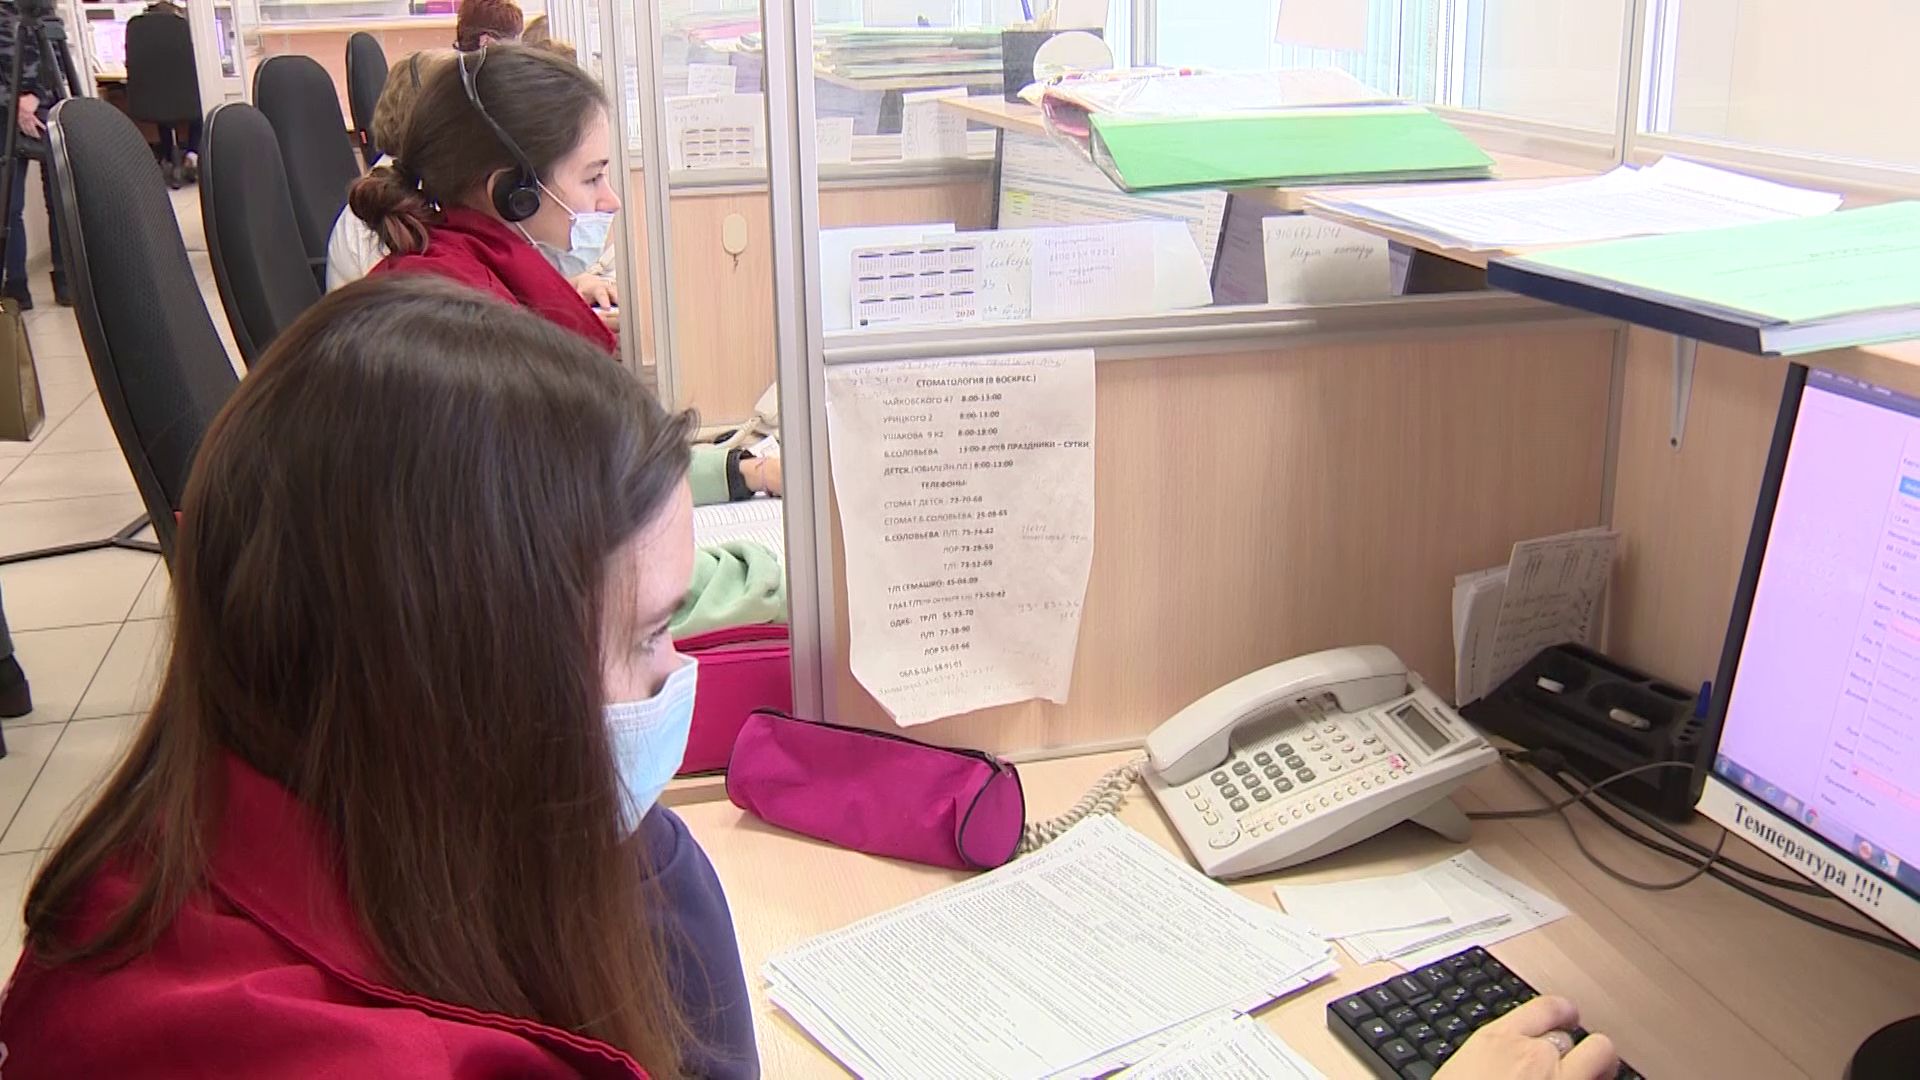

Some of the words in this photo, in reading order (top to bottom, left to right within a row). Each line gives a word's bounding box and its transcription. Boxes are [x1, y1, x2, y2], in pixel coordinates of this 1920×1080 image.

[916, 378, 984, 388] СТОМАТОЛОГИЯ
[883, 415, 926, 424] УРИЦКОГО
[882, 432, 923, 440] УШАКОВА
[1735, 801, 1847, 887] Температура
